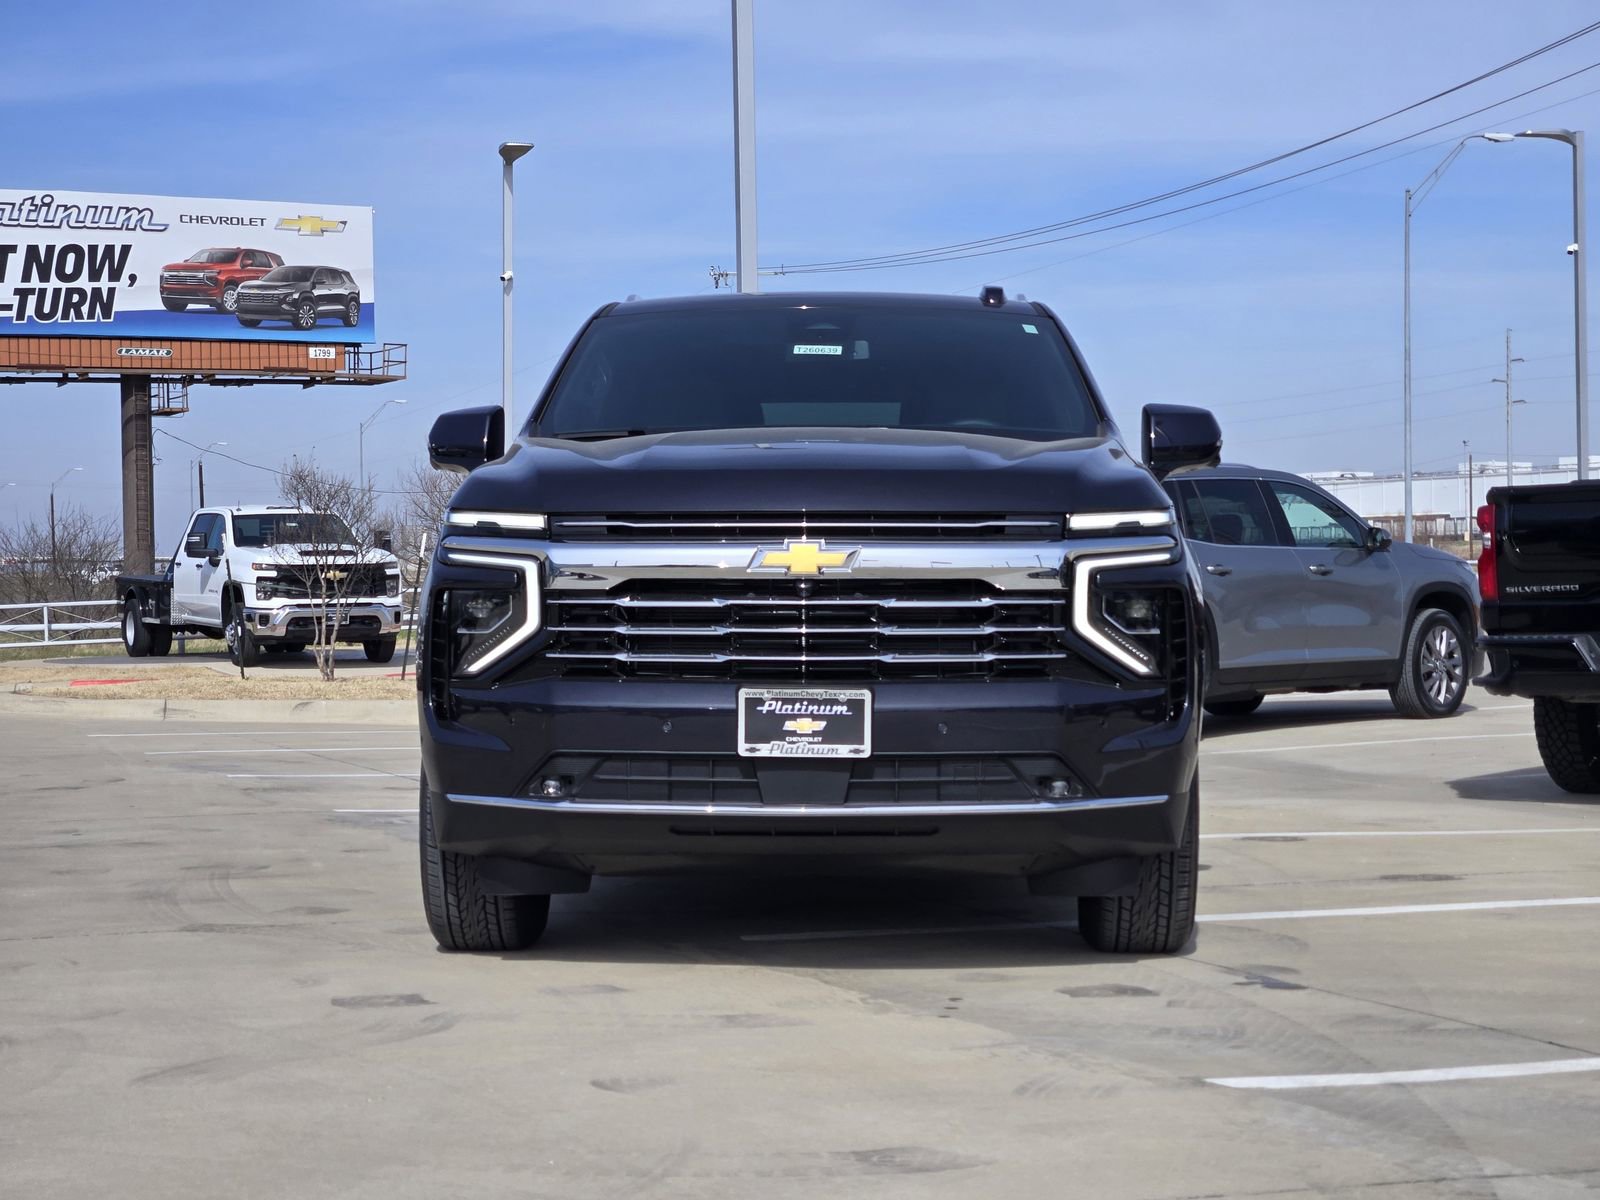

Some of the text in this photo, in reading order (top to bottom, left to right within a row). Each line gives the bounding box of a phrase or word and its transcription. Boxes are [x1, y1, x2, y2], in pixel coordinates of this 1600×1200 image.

[179, 214, 267, 227] CHEVROLET
[20, 243, 138, 288] NOW,
[121, 348, 167, 356] LAMAR
[314, 349, 331, 358] 1799
[1505, 584, 1580, 593] SILVERADO
[756, 700, 853, 715] Platinum
[768, 743, 840, 755] Platinum
